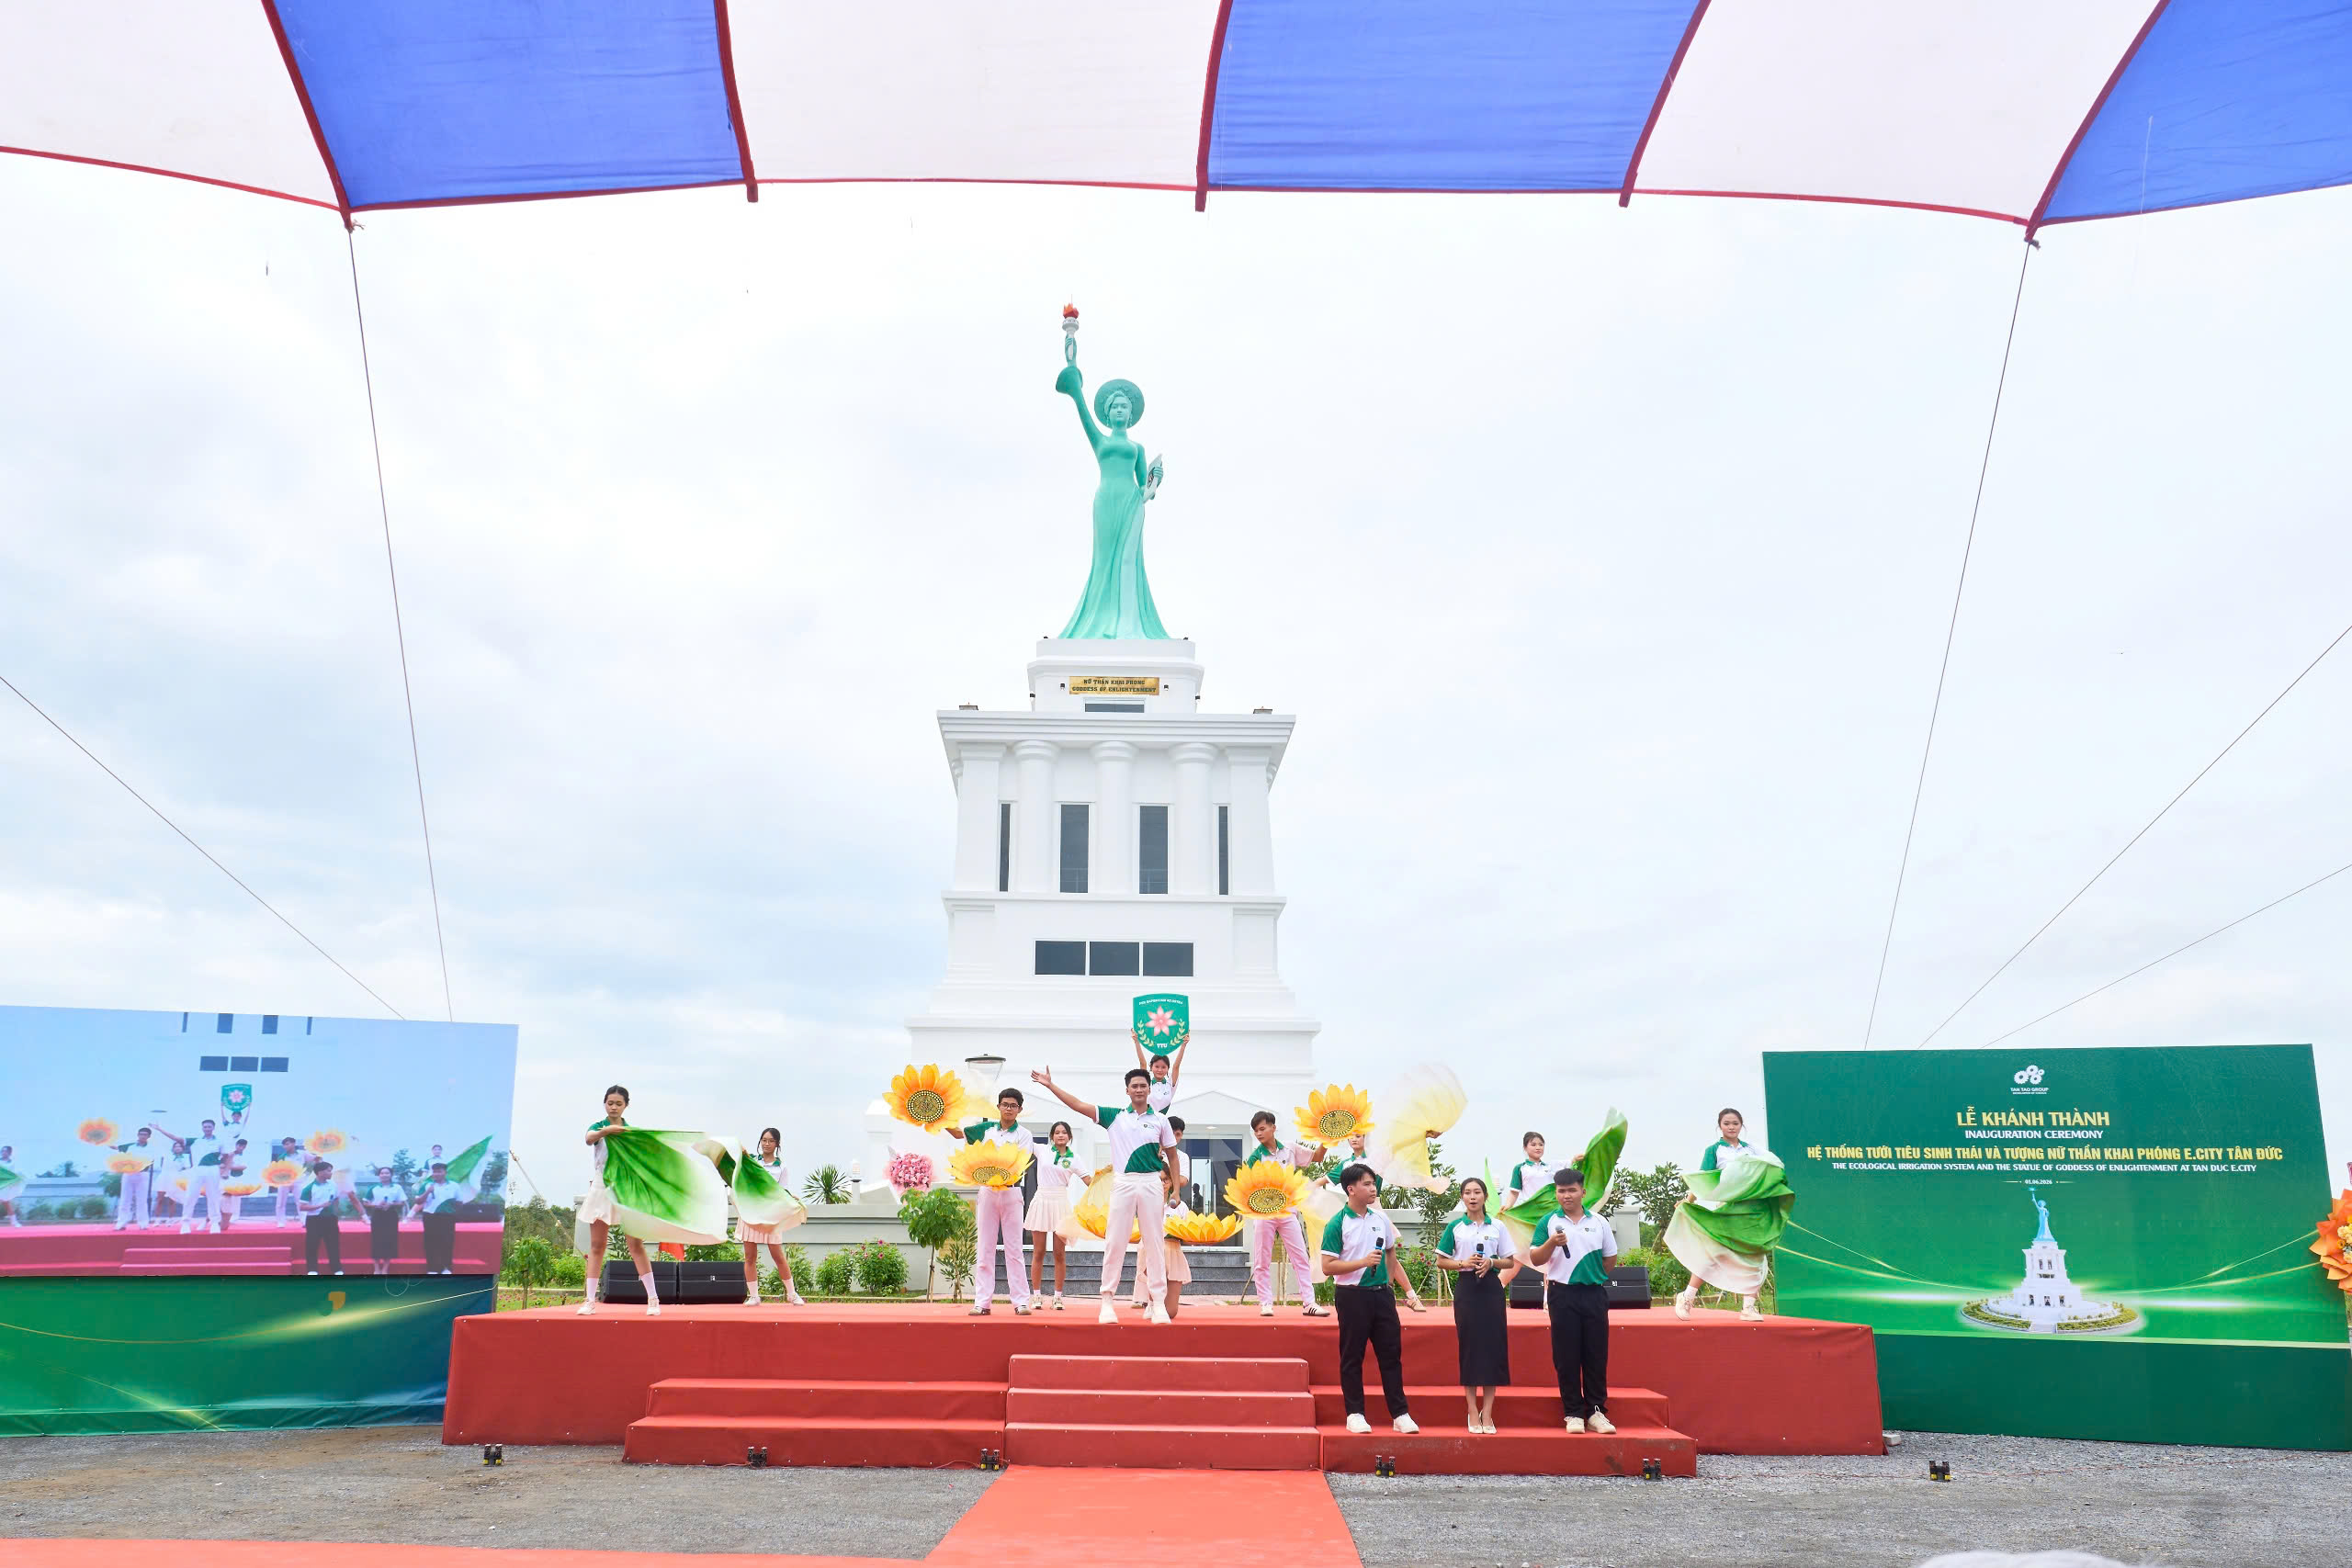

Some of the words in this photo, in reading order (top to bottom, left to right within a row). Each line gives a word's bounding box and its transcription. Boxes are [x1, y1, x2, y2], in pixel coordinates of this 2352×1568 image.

[1956, 1106, 1977, 1126] LỄ
[1982, 1108, 2044, 1126] KHÁNH
[2048, 1108, 2110, 1126] THÀNH
[1964, 1130, 2041, 1139] INAUGURATION
[2044, 1130, 2104, 1139] CEREMONY
[1807, 1145, 1823, 1161] HỆ
[1825, 1144, 1863, 1159] THỐNG
[1894, 1145, 1921, 1159] TIÊU
[1924, 1146, 1953, 1159] SINH
[1954, 1145, 1983, 1159] THÁI
[1984, 1145, 2002, 1159] VÀ
[2004, 1146, 2045, 1162] TƯỢNG
[2047, 1145, 2066, 1160] NỮ
[2067, 1145, 2101, 1160] THẦN
[2104, 1147, 2134, 1160] KHAI
[2137, 1145, 2181, 1160] PHÓNG
[2184, 1147, 2223, 1160] E.CITY
[2226, 1145, 2254, 1160] TÂN
[2256, 1145, 2284, 1160] ĐỨC
[1849, 1162, 1897, 1170] ECOLOGICAL
[2013, 1163, 2041, 1171] STATUE
[2042, 1163, 2053, 1171] OF
[2231, 1164, 2256, 1172] E.CITY
